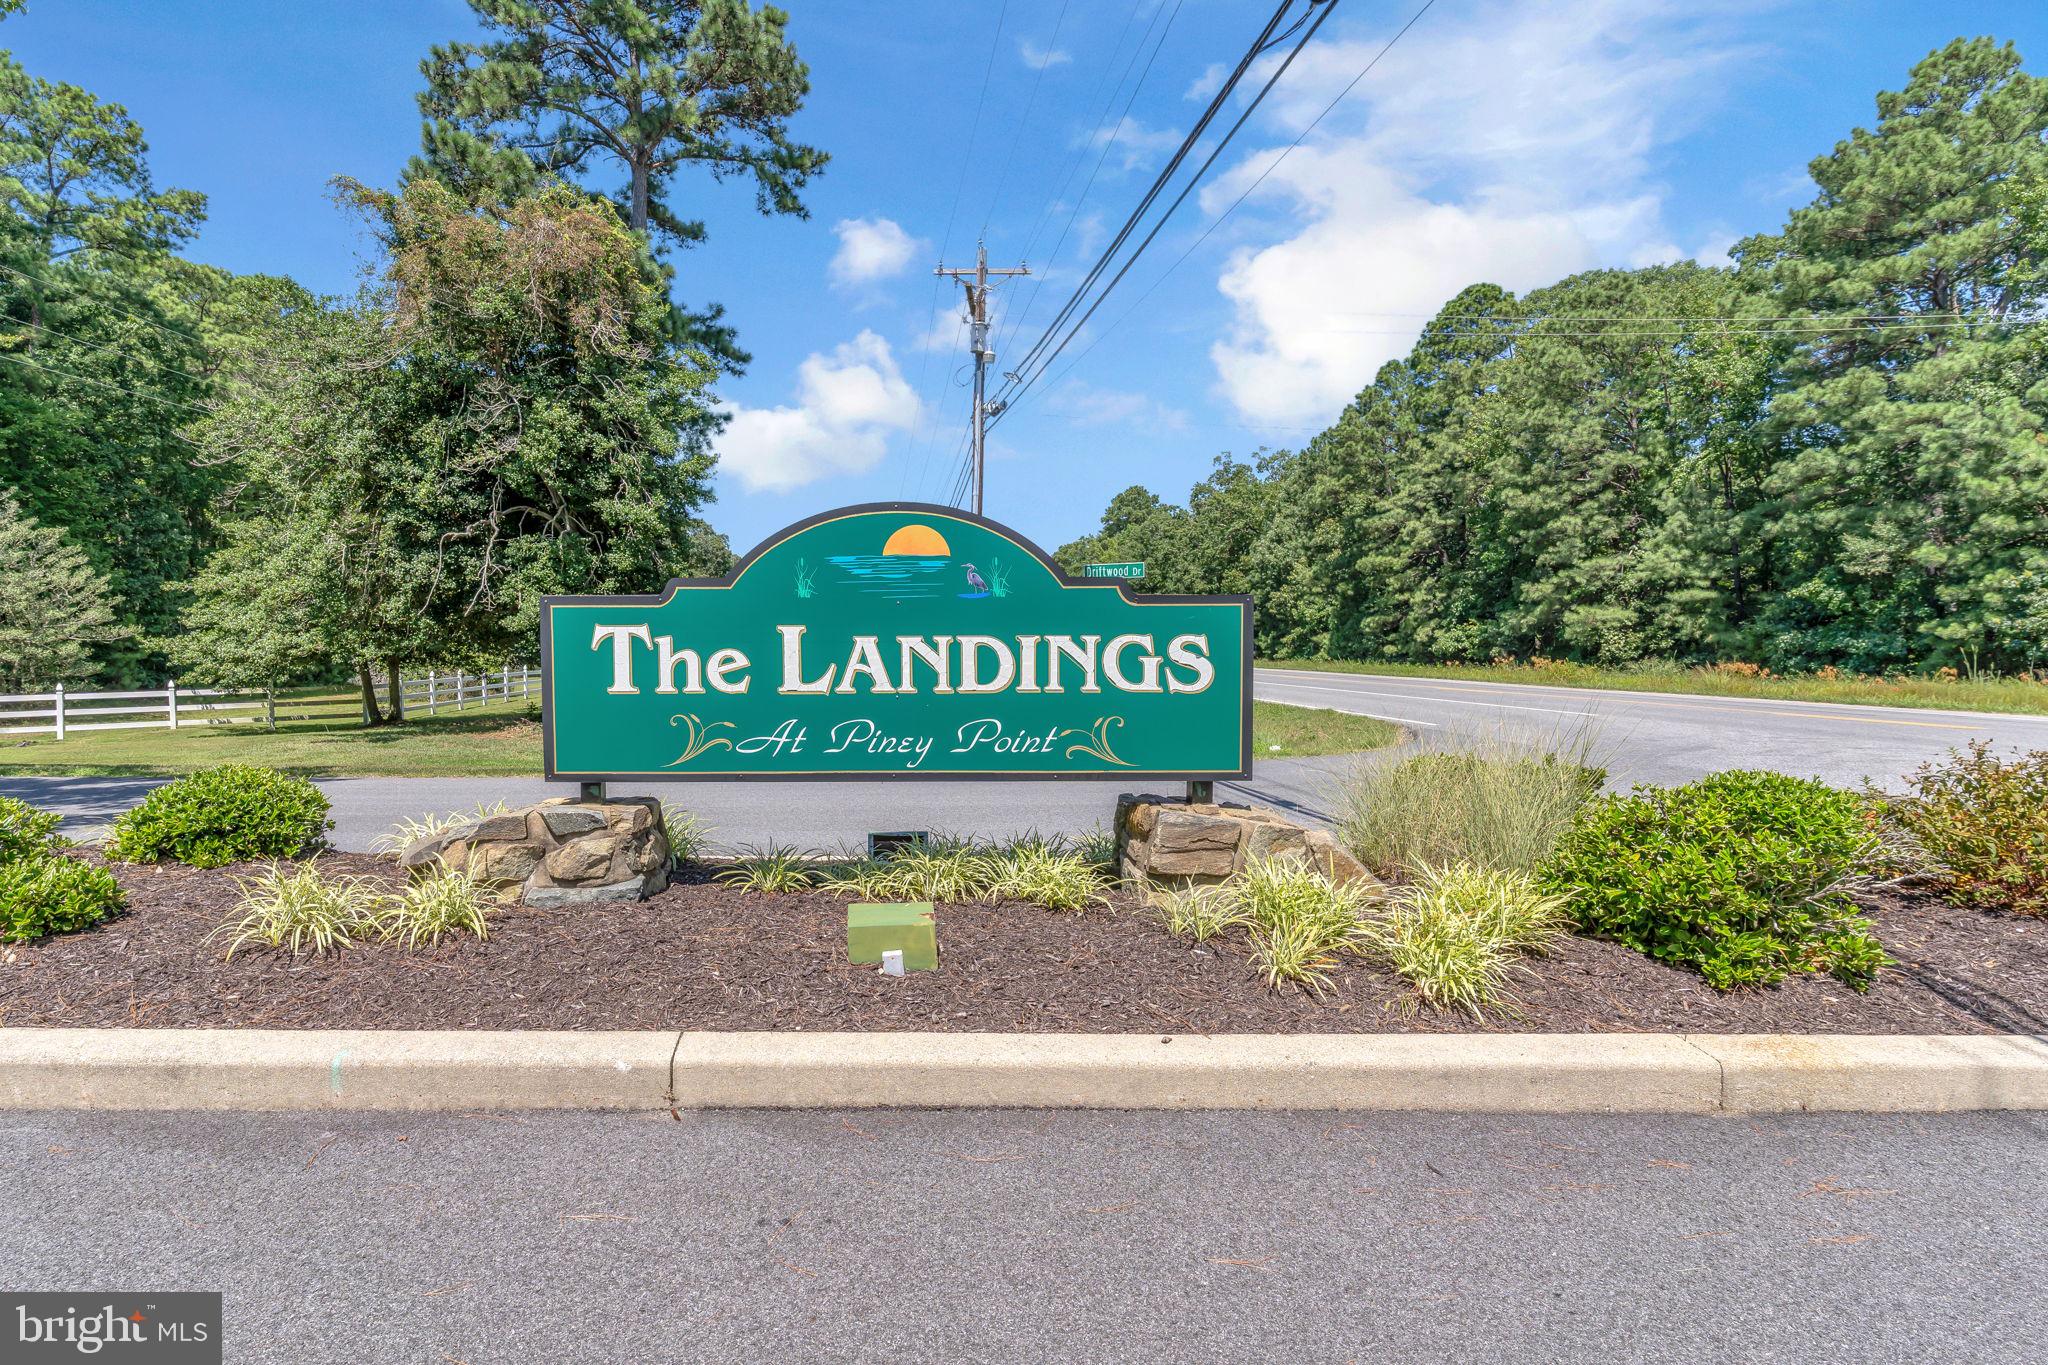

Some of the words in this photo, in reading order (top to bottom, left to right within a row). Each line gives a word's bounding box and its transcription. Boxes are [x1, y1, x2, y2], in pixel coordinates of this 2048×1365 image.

[1086, 566, 1129, 577] Driftwood
[1132, 567, 1141, 576] Dr
[591, 623, 751, 695] The
[776, 623, 1215, 695] LANDINGS
[735, 717, 806, 755] At
[822, 718, 934, 768] Piney
[950, 718, 1062, 755] Point
